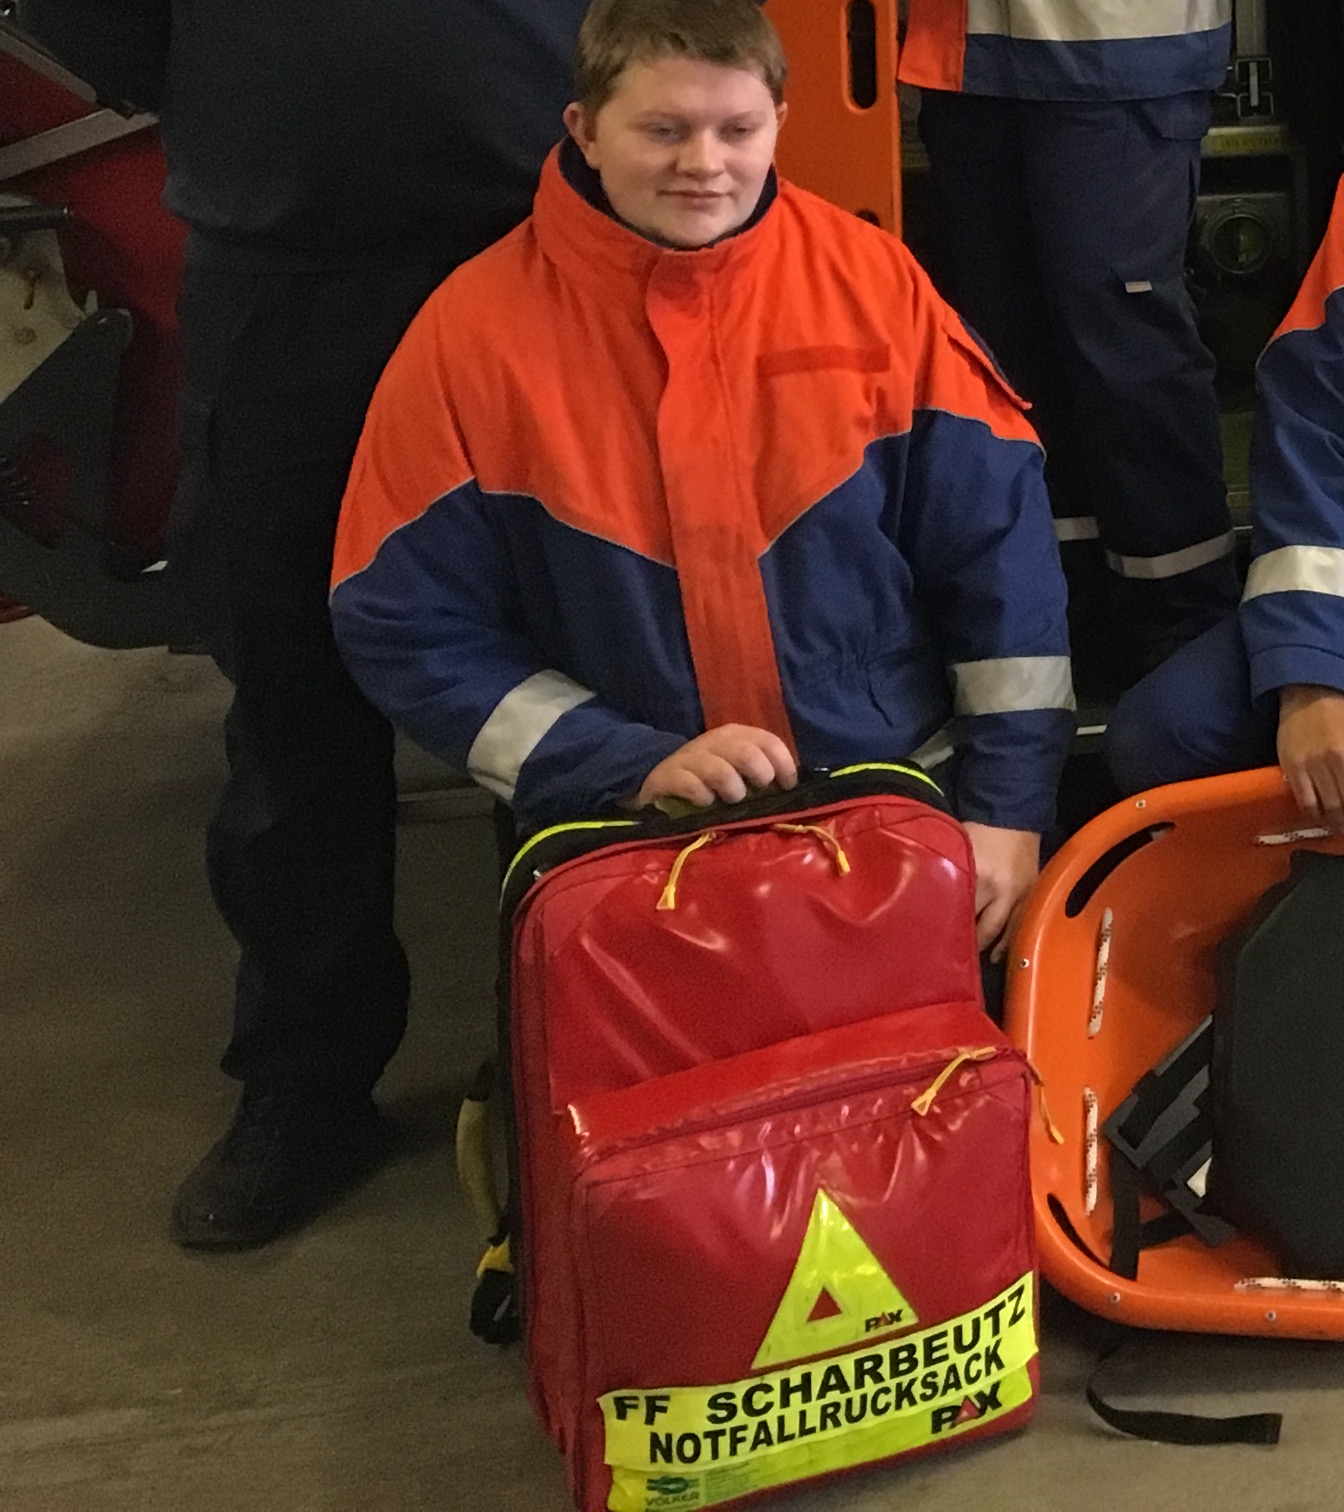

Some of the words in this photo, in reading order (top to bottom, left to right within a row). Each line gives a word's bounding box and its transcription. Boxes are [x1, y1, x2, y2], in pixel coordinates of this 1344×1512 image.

[612, 1395, 671, 1426] FF
[706, 1283, 1027, 1425] SCHARBEUTZ
[864, 1308, 904, 1333] PAX
[648, 1339, 1006, 1465] NOTFALLRUCKSACK
[931, 1383, 1003, 1436] PAX
